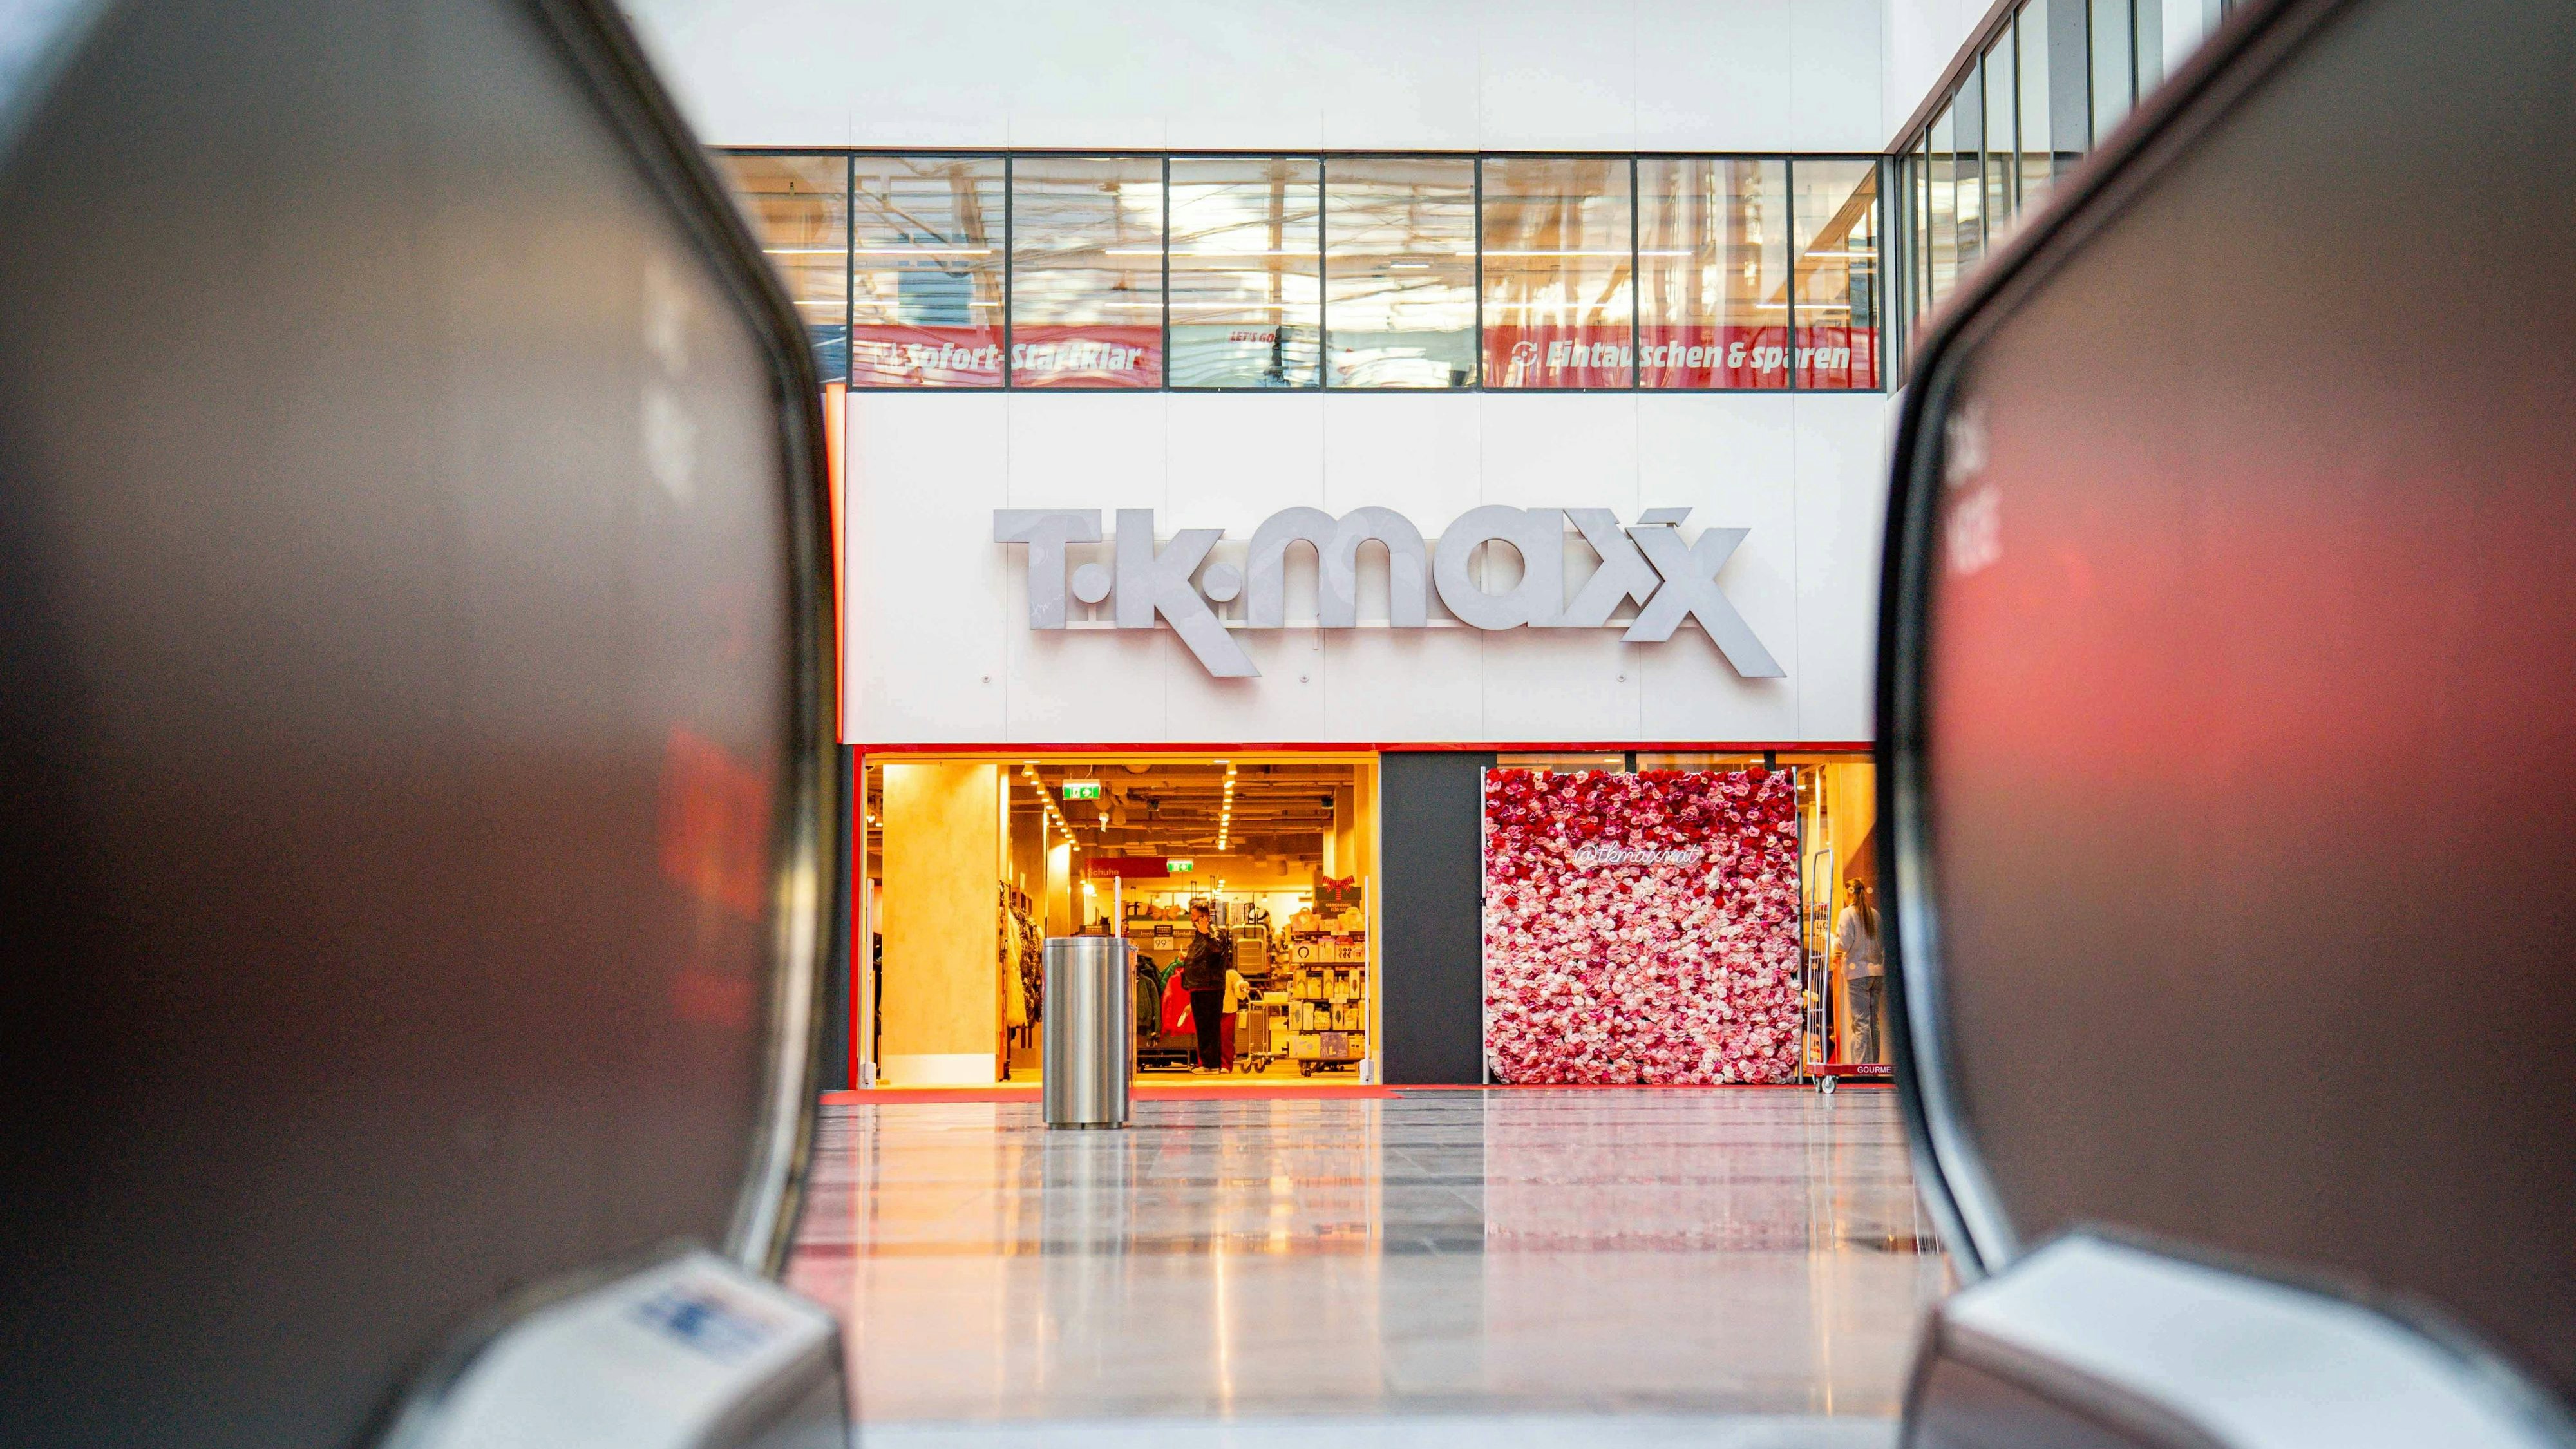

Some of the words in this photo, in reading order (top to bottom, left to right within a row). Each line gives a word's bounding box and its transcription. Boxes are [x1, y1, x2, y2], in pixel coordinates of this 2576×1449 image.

[1229, 331, 1258, 342] LET'S
[1547, 341, 1722, 368] Eintauschen
[1728, 342, 1747, 368] &
[1750, 342, 1850, 374] sparen
[1573, 840, 1700, 869] @tkmaxxat
[1087, 867, 1119, 876] Schuhe
[1155, 939, 1167, 947] 99
